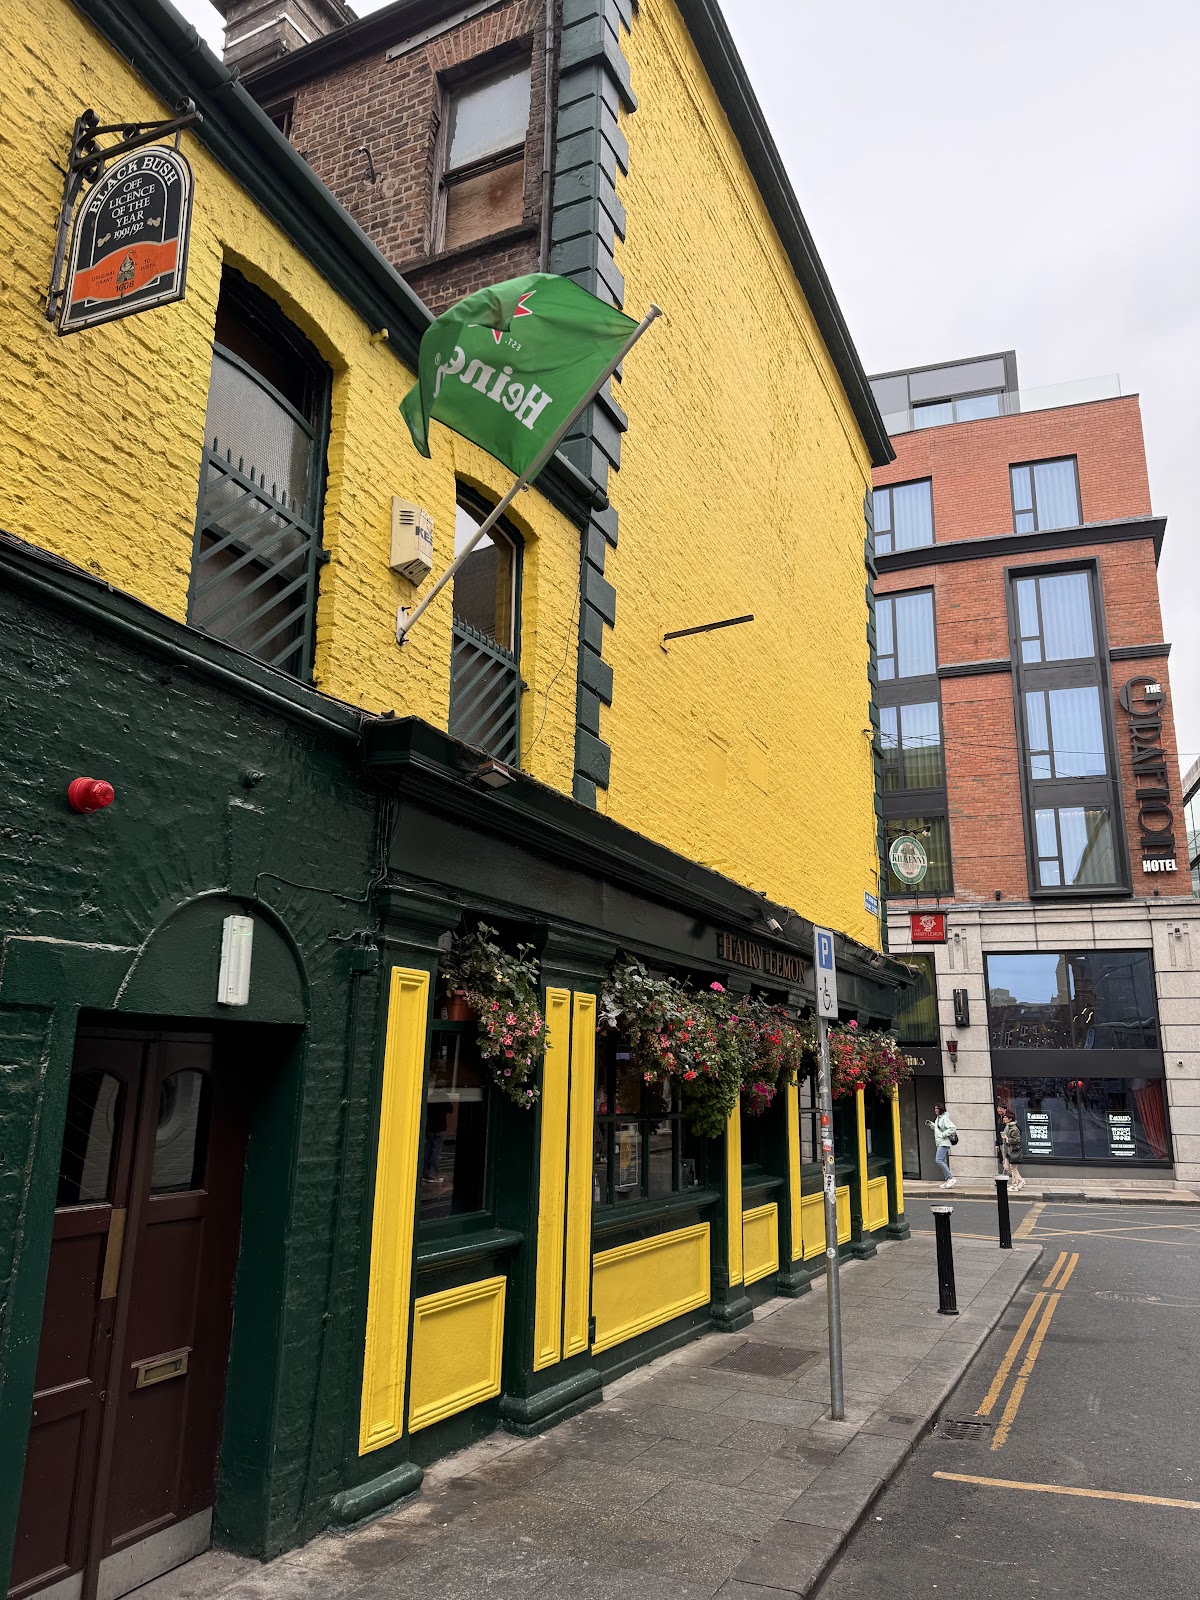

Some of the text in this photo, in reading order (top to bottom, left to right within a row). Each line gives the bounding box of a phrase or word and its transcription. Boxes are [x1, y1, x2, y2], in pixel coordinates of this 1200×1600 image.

[88, 157, 178, 214] BLACK BUSH
[123, 178, 143, 193] OFF
[109, 184, 155, 209] LICENCE
[111, 197, 151, 219] OF THE
[116, 210, 144, 228] YEAR
[113, 222, 145, 241] 1991/92
[115, 280, 135, 292] 1608
[1144, 683, 1161, 694] THE
[1119, 675, 1177, 861] GRAFTON
[891, 853, 926, 865] KILKENNY
[1142, 859, 1178, 873] HOTEL
[718, 932, 806, 984] HAIRY LEMON
[821, 937, 829, 966] P
